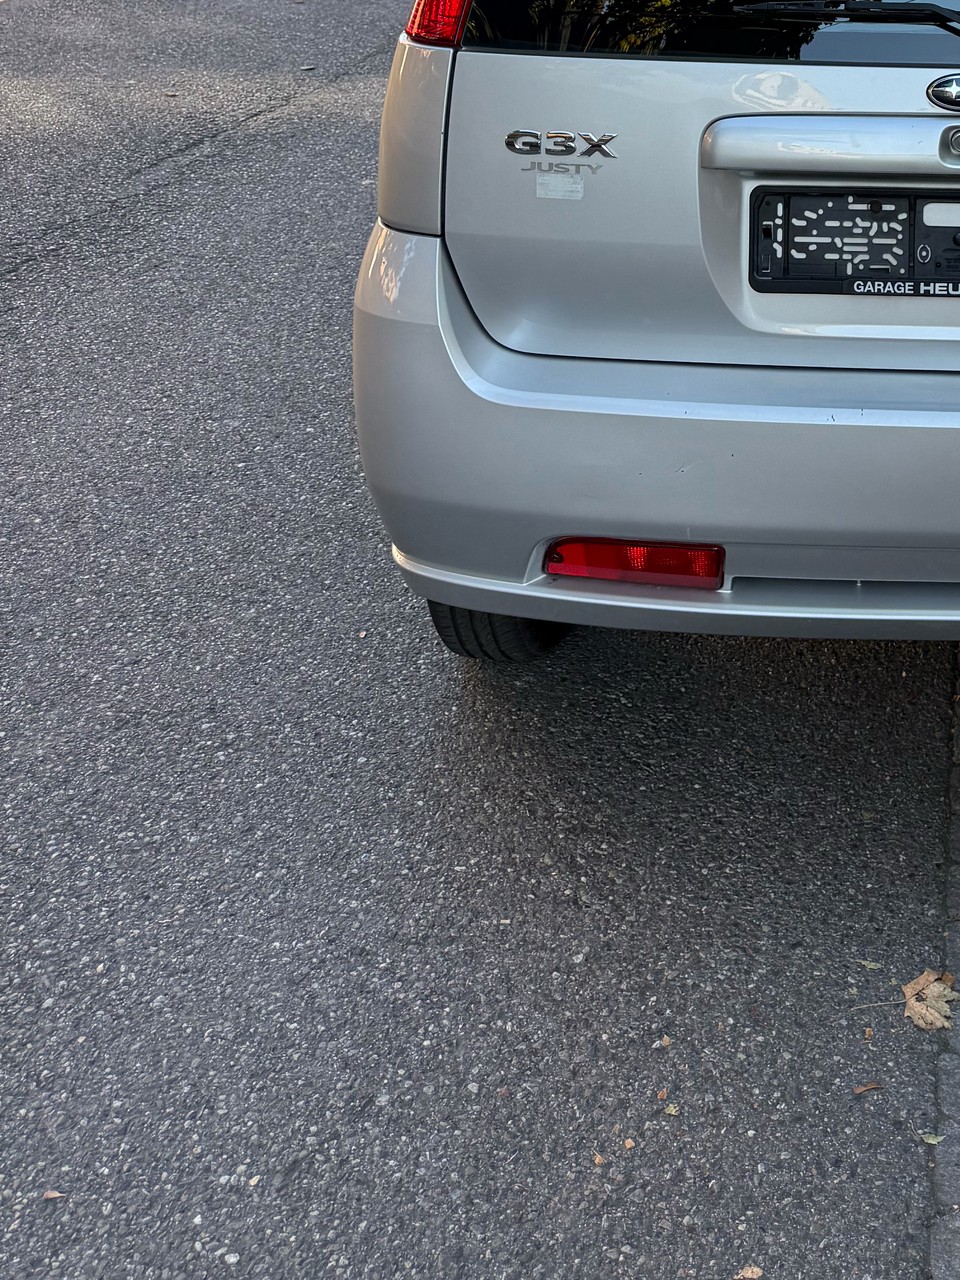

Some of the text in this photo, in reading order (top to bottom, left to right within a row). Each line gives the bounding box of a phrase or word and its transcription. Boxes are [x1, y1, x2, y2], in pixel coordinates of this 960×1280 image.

[504, 129, 619, 159] G3X
[521, 161, 603, 175] JUSTY
[853, 281, 914, 294] GARAGE
